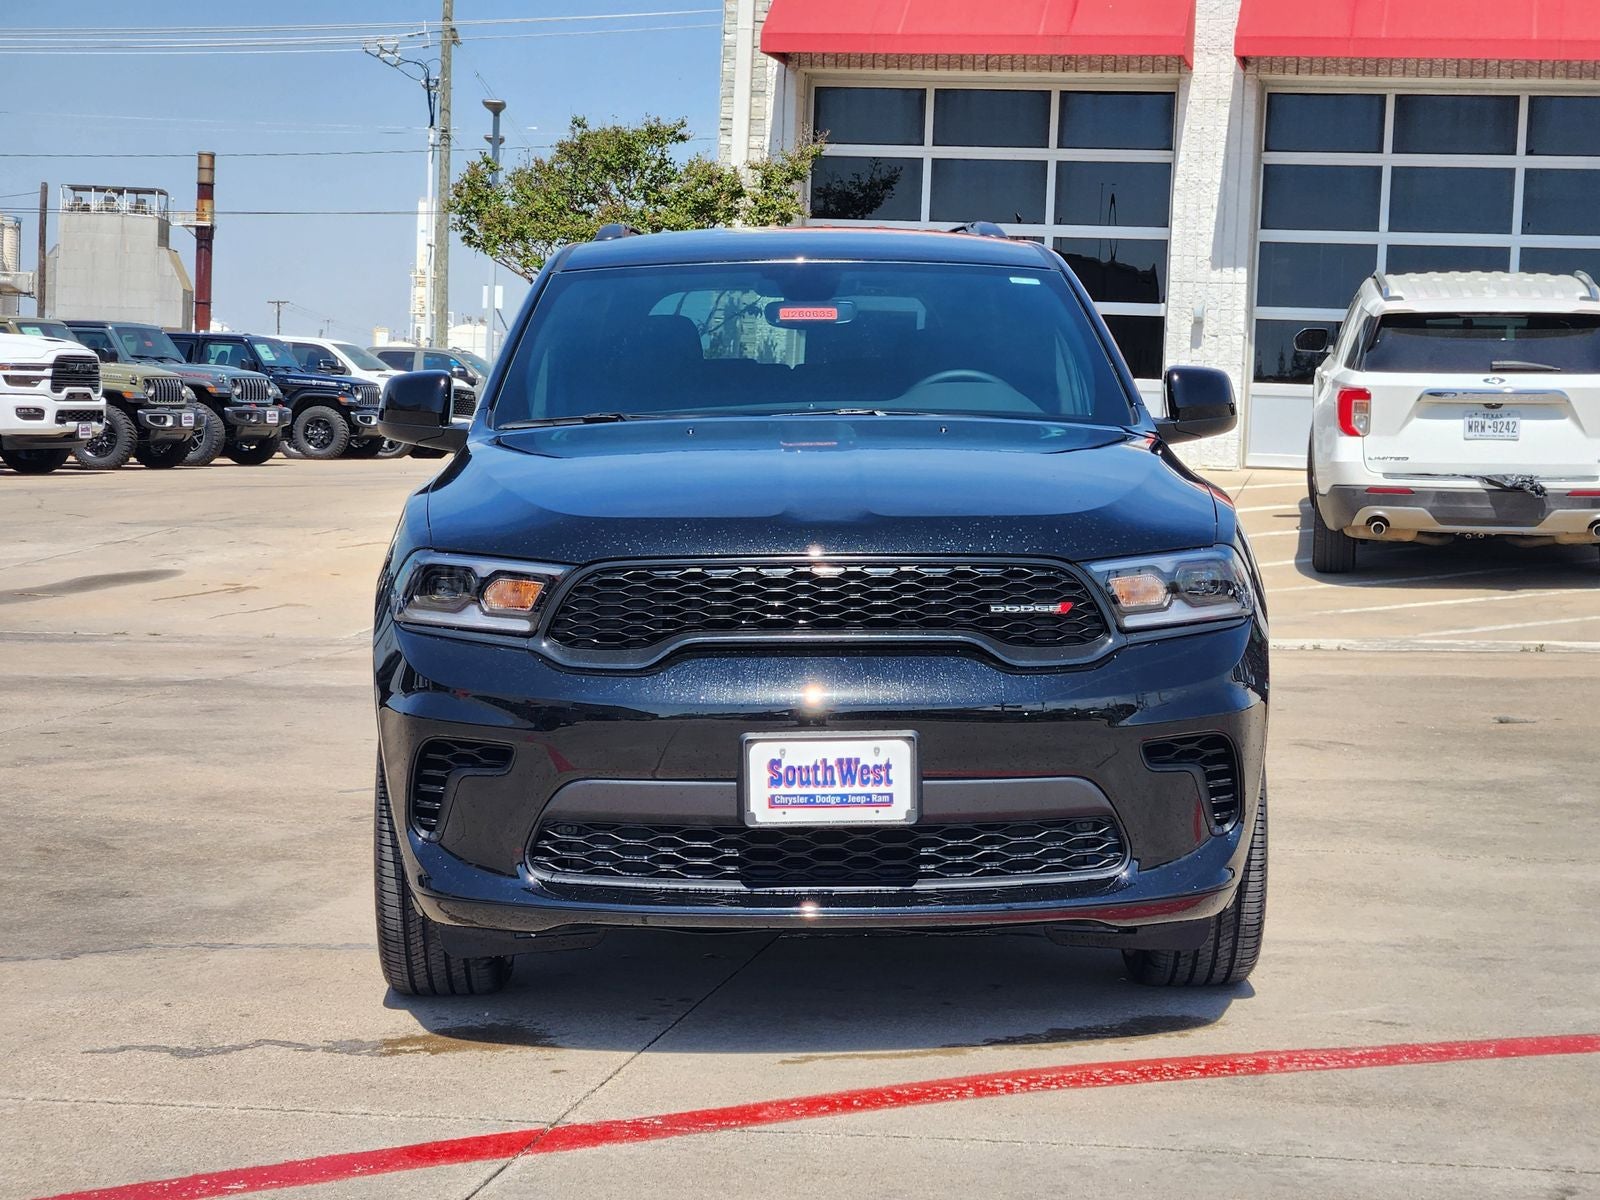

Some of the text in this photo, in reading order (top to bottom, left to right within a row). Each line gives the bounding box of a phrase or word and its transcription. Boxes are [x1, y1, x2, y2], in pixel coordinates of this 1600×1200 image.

[990, 604, 1062, 613] DODGE
[767, 757, 893, 788] SouthWest
[775, 794, 890, 805] Chrysler Dodge Jeep Ram
